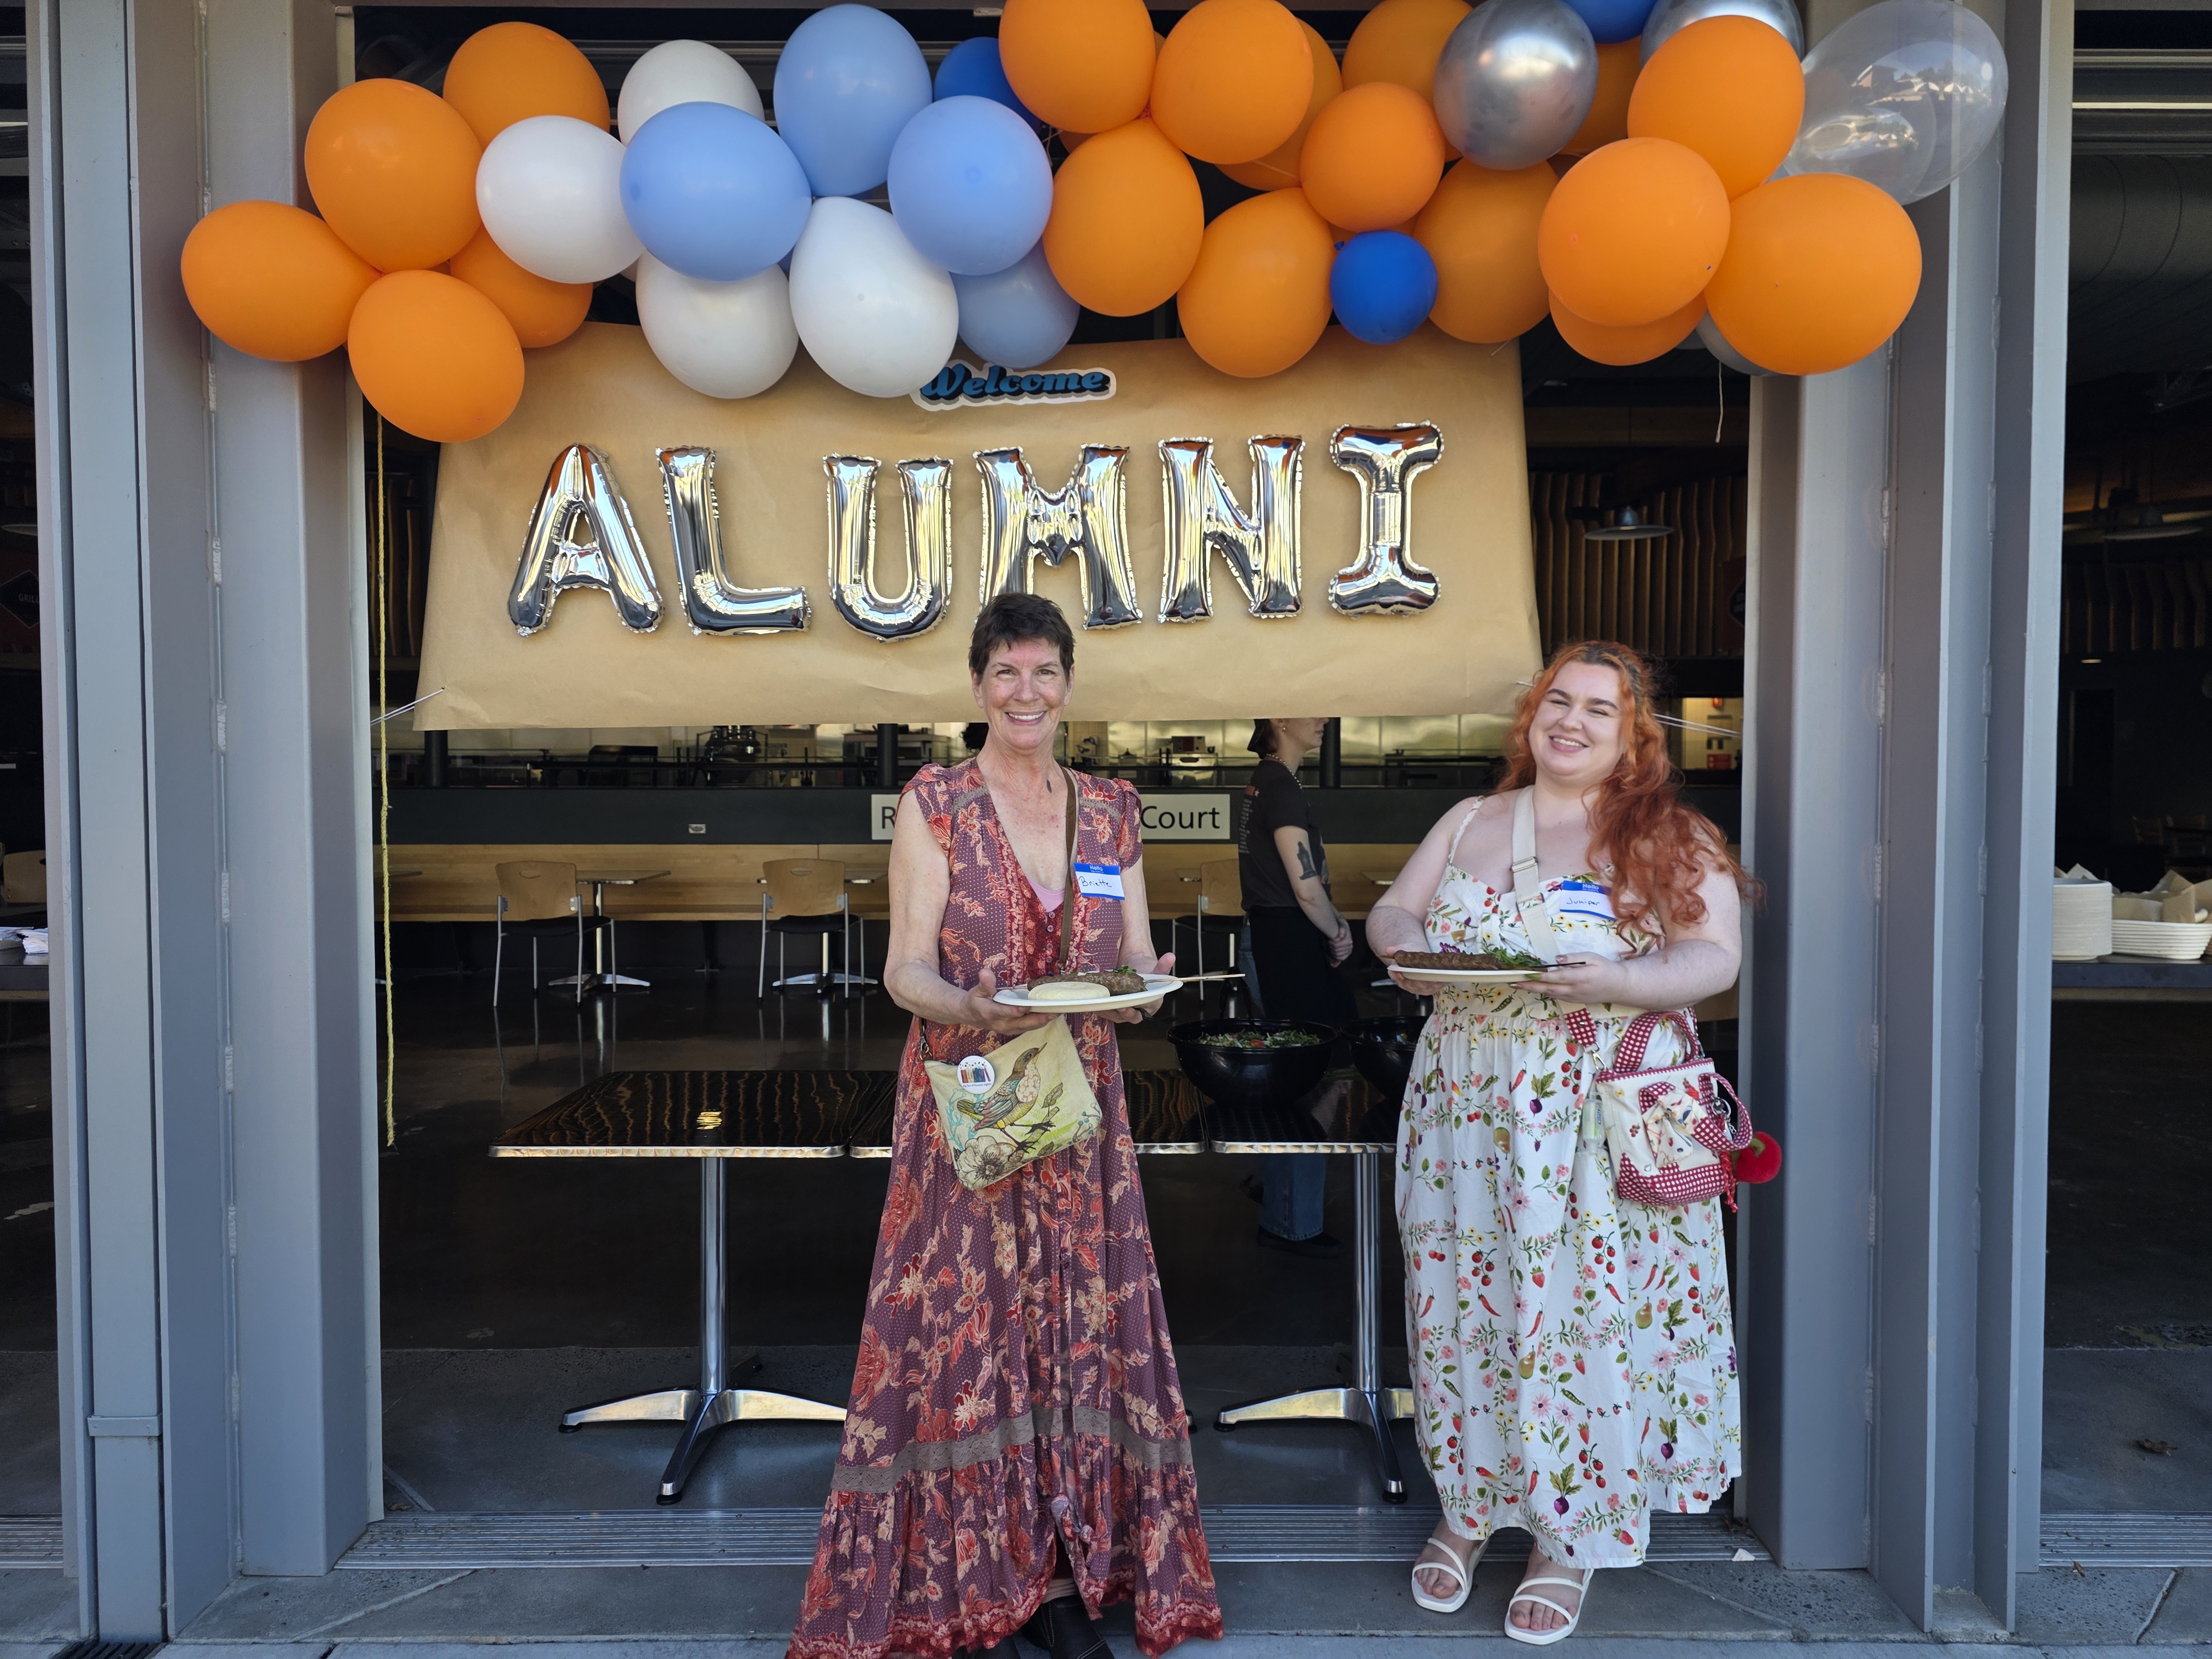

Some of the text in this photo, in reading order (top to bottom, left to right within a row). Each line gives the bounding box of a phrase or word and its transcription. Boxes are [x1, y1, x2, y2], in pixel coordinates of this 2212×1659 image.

[920, 363, 1110, 402] Welcome
[508, 420, 1444, 643] ALUMNI
[1140, 805, 1220, 829] Court
[1567, 897, 1600, 906] Juniper
